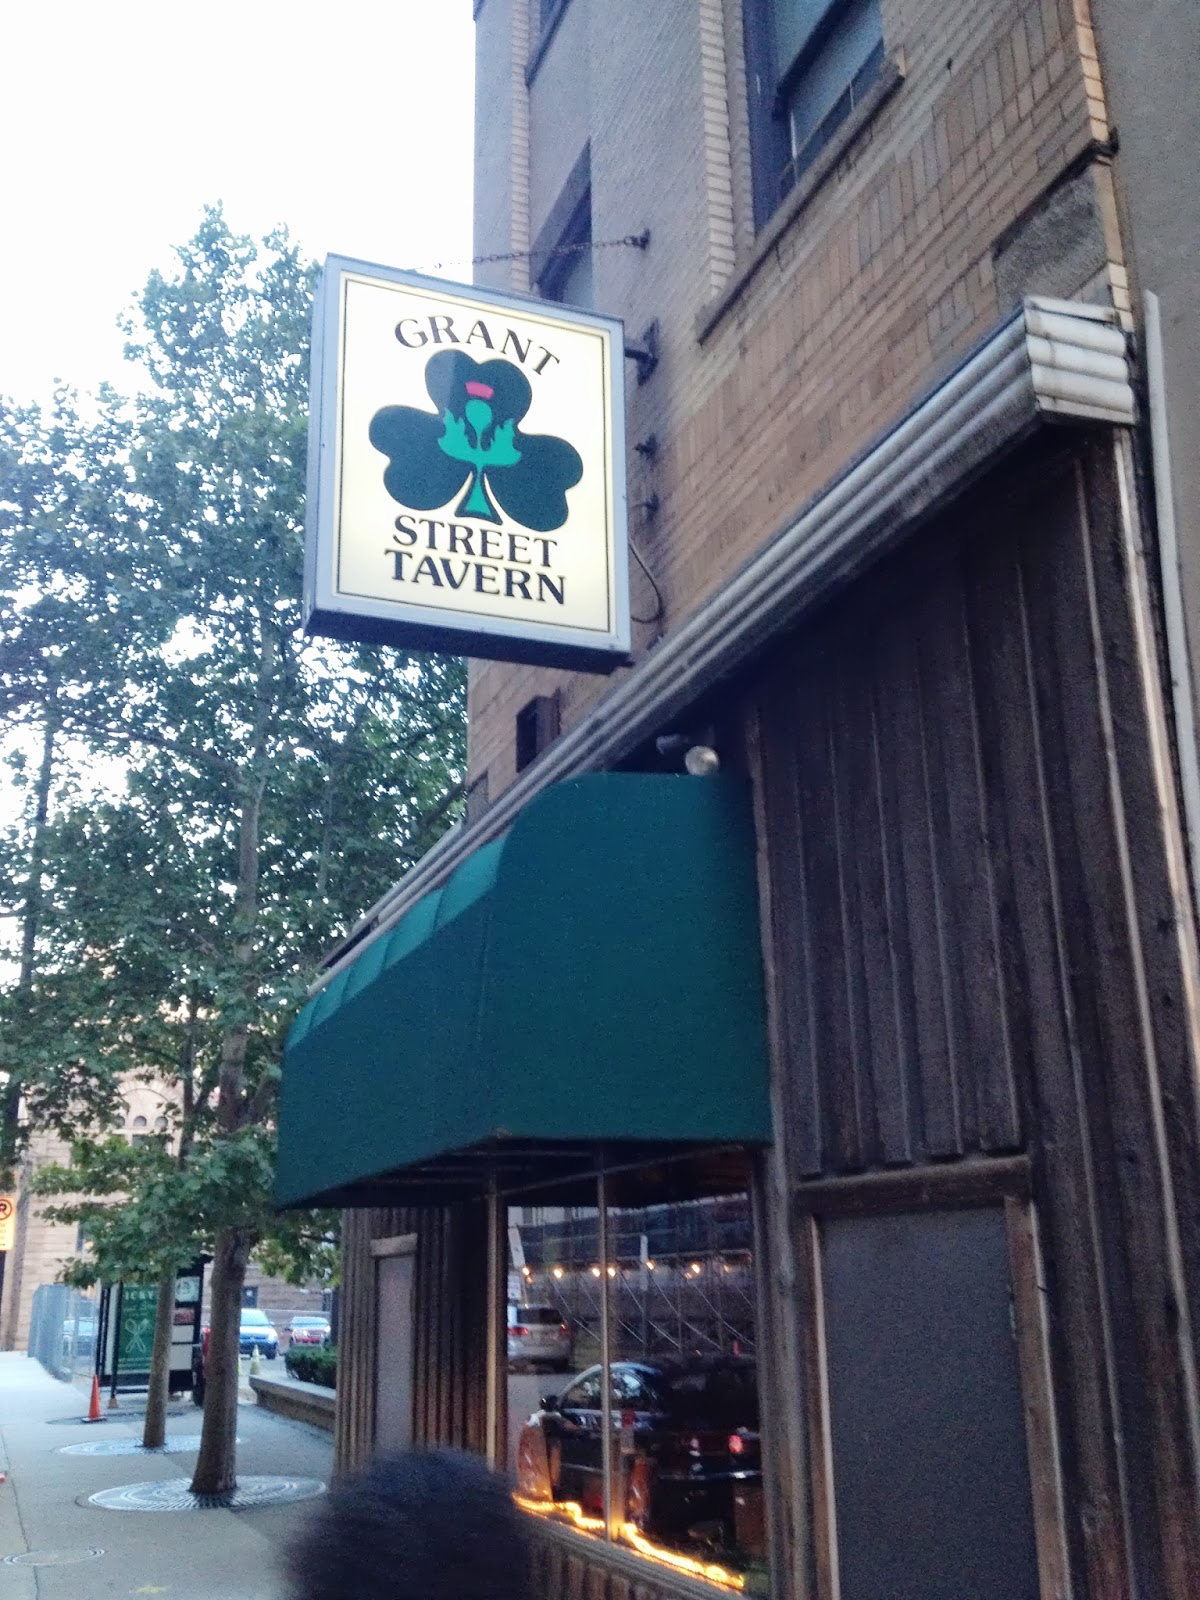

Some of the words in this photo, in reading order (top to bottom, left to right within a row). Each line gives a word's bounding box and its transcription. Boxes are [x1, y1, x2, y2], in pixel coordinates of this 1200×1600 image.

[395, 315, 560, 375] GRANT
[392, 515, 557, 567] STREET
[384, 549, 566, 604] TAVERN
